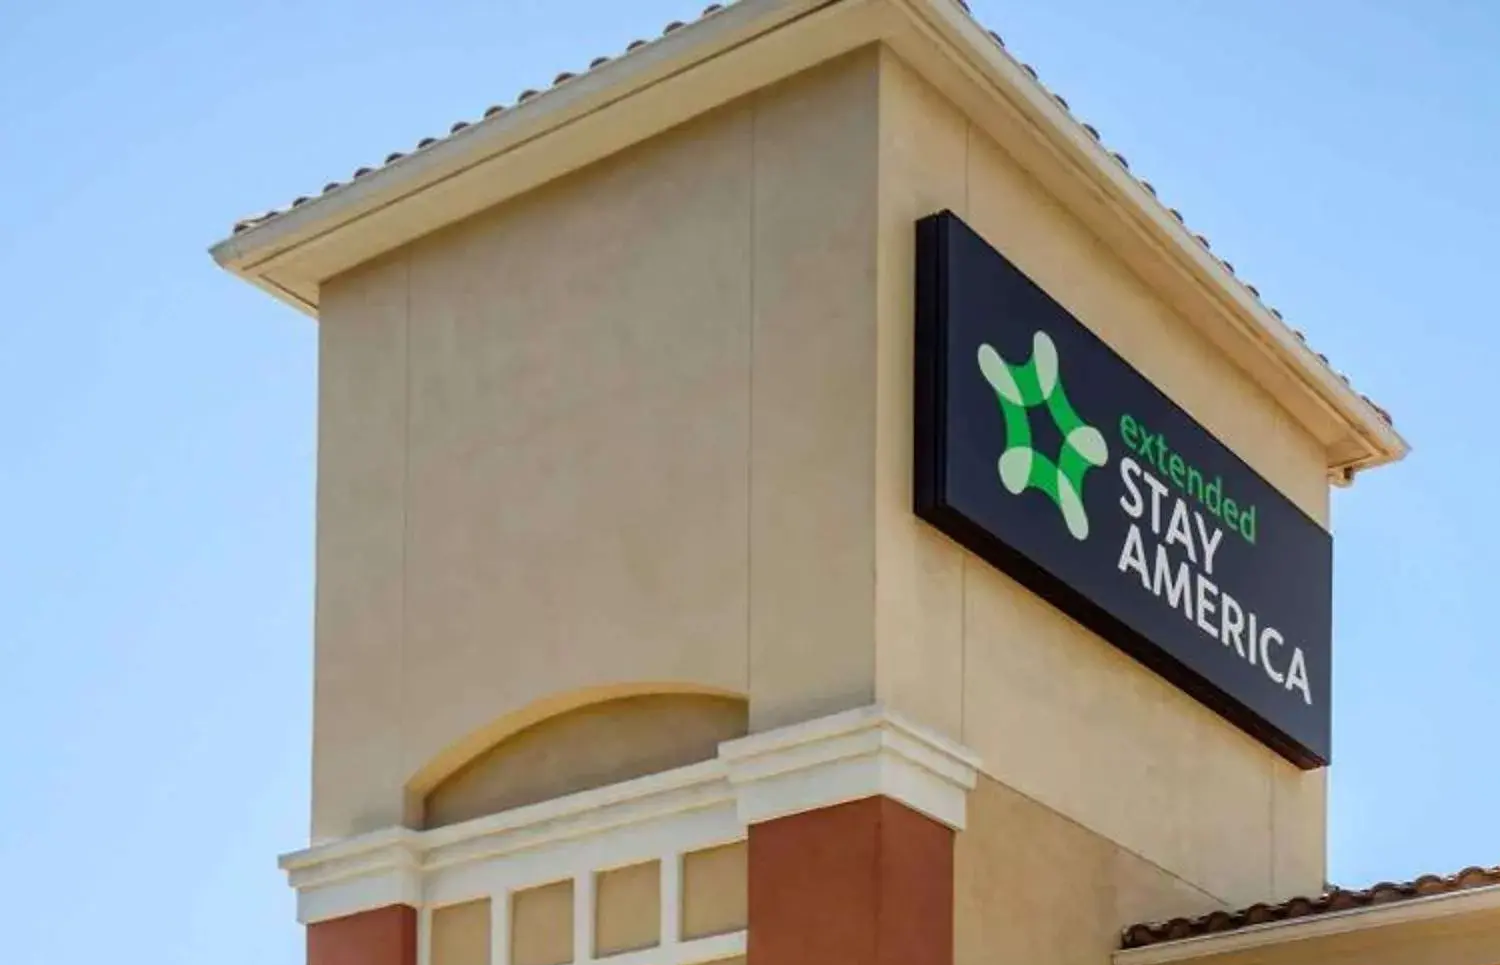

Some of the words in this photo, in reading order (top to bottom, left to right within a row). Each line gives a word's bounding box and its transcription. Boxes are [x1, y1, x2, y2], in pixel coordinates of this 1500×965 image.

[1119, 413, 1256, 545] extended
[1119, 456, 1223, 575] STAY
[1117, 523, 1312, 705] AMERICA
